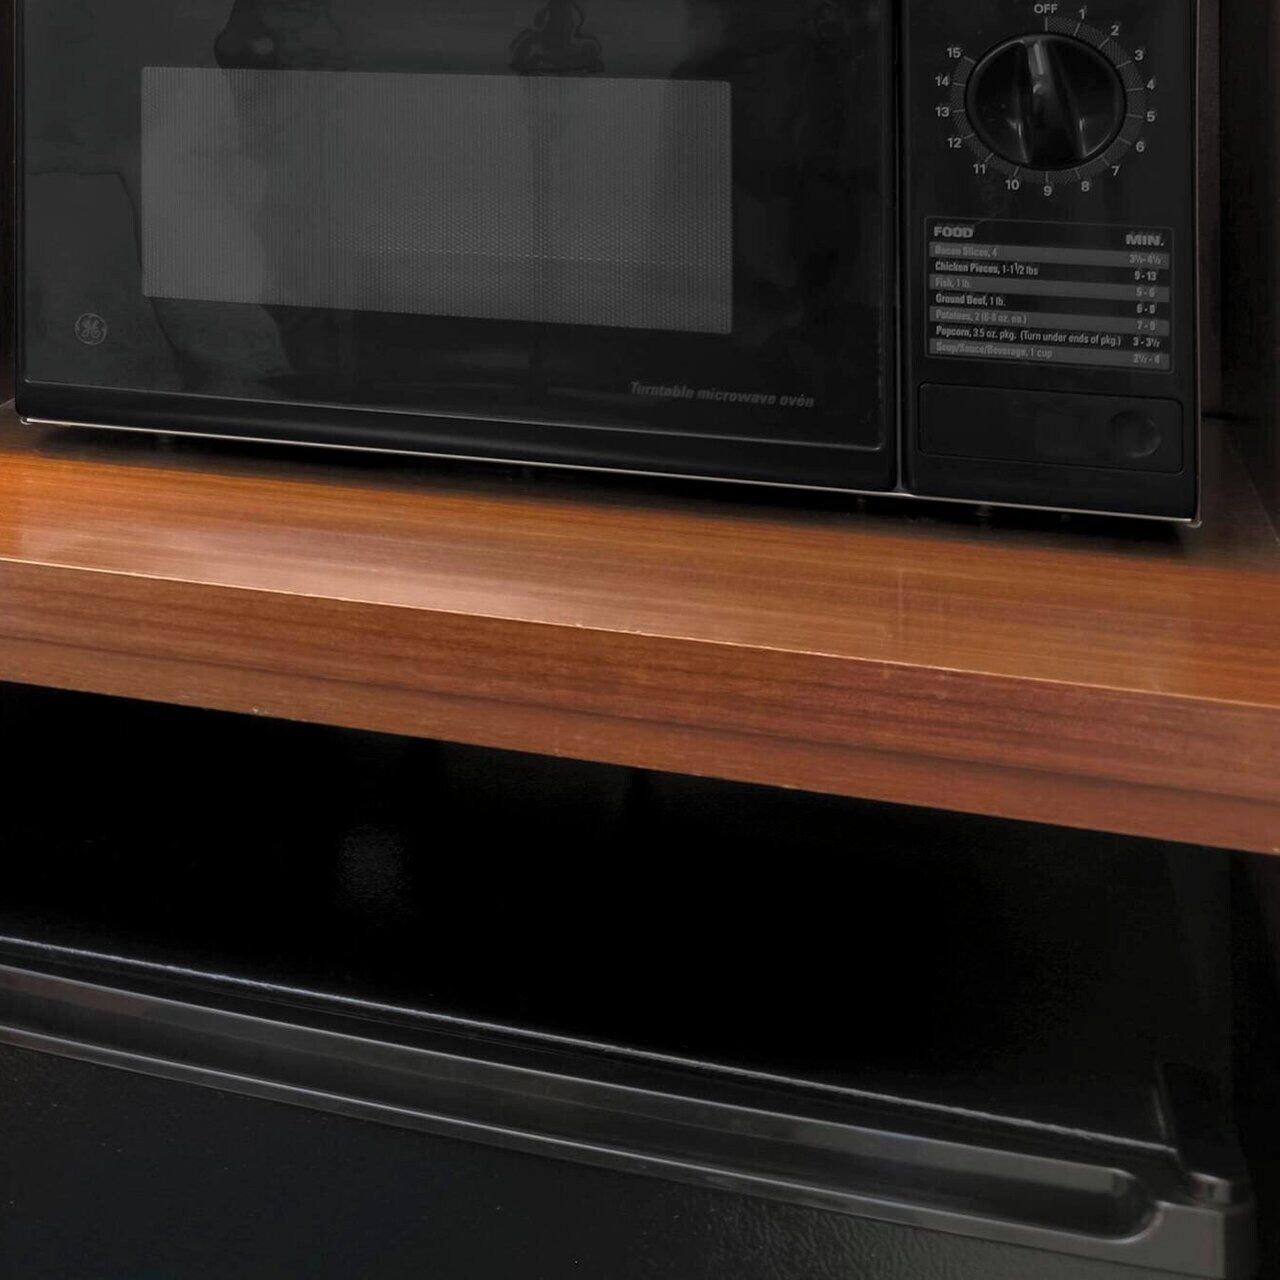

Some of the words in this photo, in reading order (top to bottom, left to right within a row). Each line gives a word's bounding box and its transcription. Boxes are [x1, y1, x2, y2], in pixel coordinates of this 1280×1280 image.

[1034, 3, 1058, 15] OFF
[1079, 7, 1087, 20] 1
[1110, 24, 1120, 36] 2
[946, 47, 961, 59] 15
[1134, 49, 1144, 61] 3
[934, 75, 950, 87] 14
[1146, 78, 1155, 90] 4
[934, 106, 950, 118] 13
[1146, 110, 1156, 122] 5
[947, 137, 962, 149] 12
[1135, 140, 1145, 153] 6
[972, 163, 986, 175] 11
[1111, 165, 1120, 176] 7
[1005, 179, 1020, 191] 10
[1043, 185, 1053, 197] 9
[1080, 181, 1090, 193] 8
[933, 226, 974, 238] FOOD
[1125, 233, 1165, 247] MIN.
[935, 261, 968, 272] Chicken
[970, 263, 1001, 275] Pieces,
[936, 293, 965, 305] Ground
[966, 295, 989, 307] Beef,
[936, 325, 972, 338] Popcorn,
[999, 329, 1017, 341] pkg.
[1020, 329, 1042, 341] (Turn
[1043, 332, 1066, 343] under
[1068, 333, 1089, 345] ends
[1090, 334, 1100, 345] of
[1100, 335, 1122, 348] pkg.)
[630, 381, 695, 399] Turntable
[697, 387, 776, 405] microwave
[779, 393, 815, 408] oven
